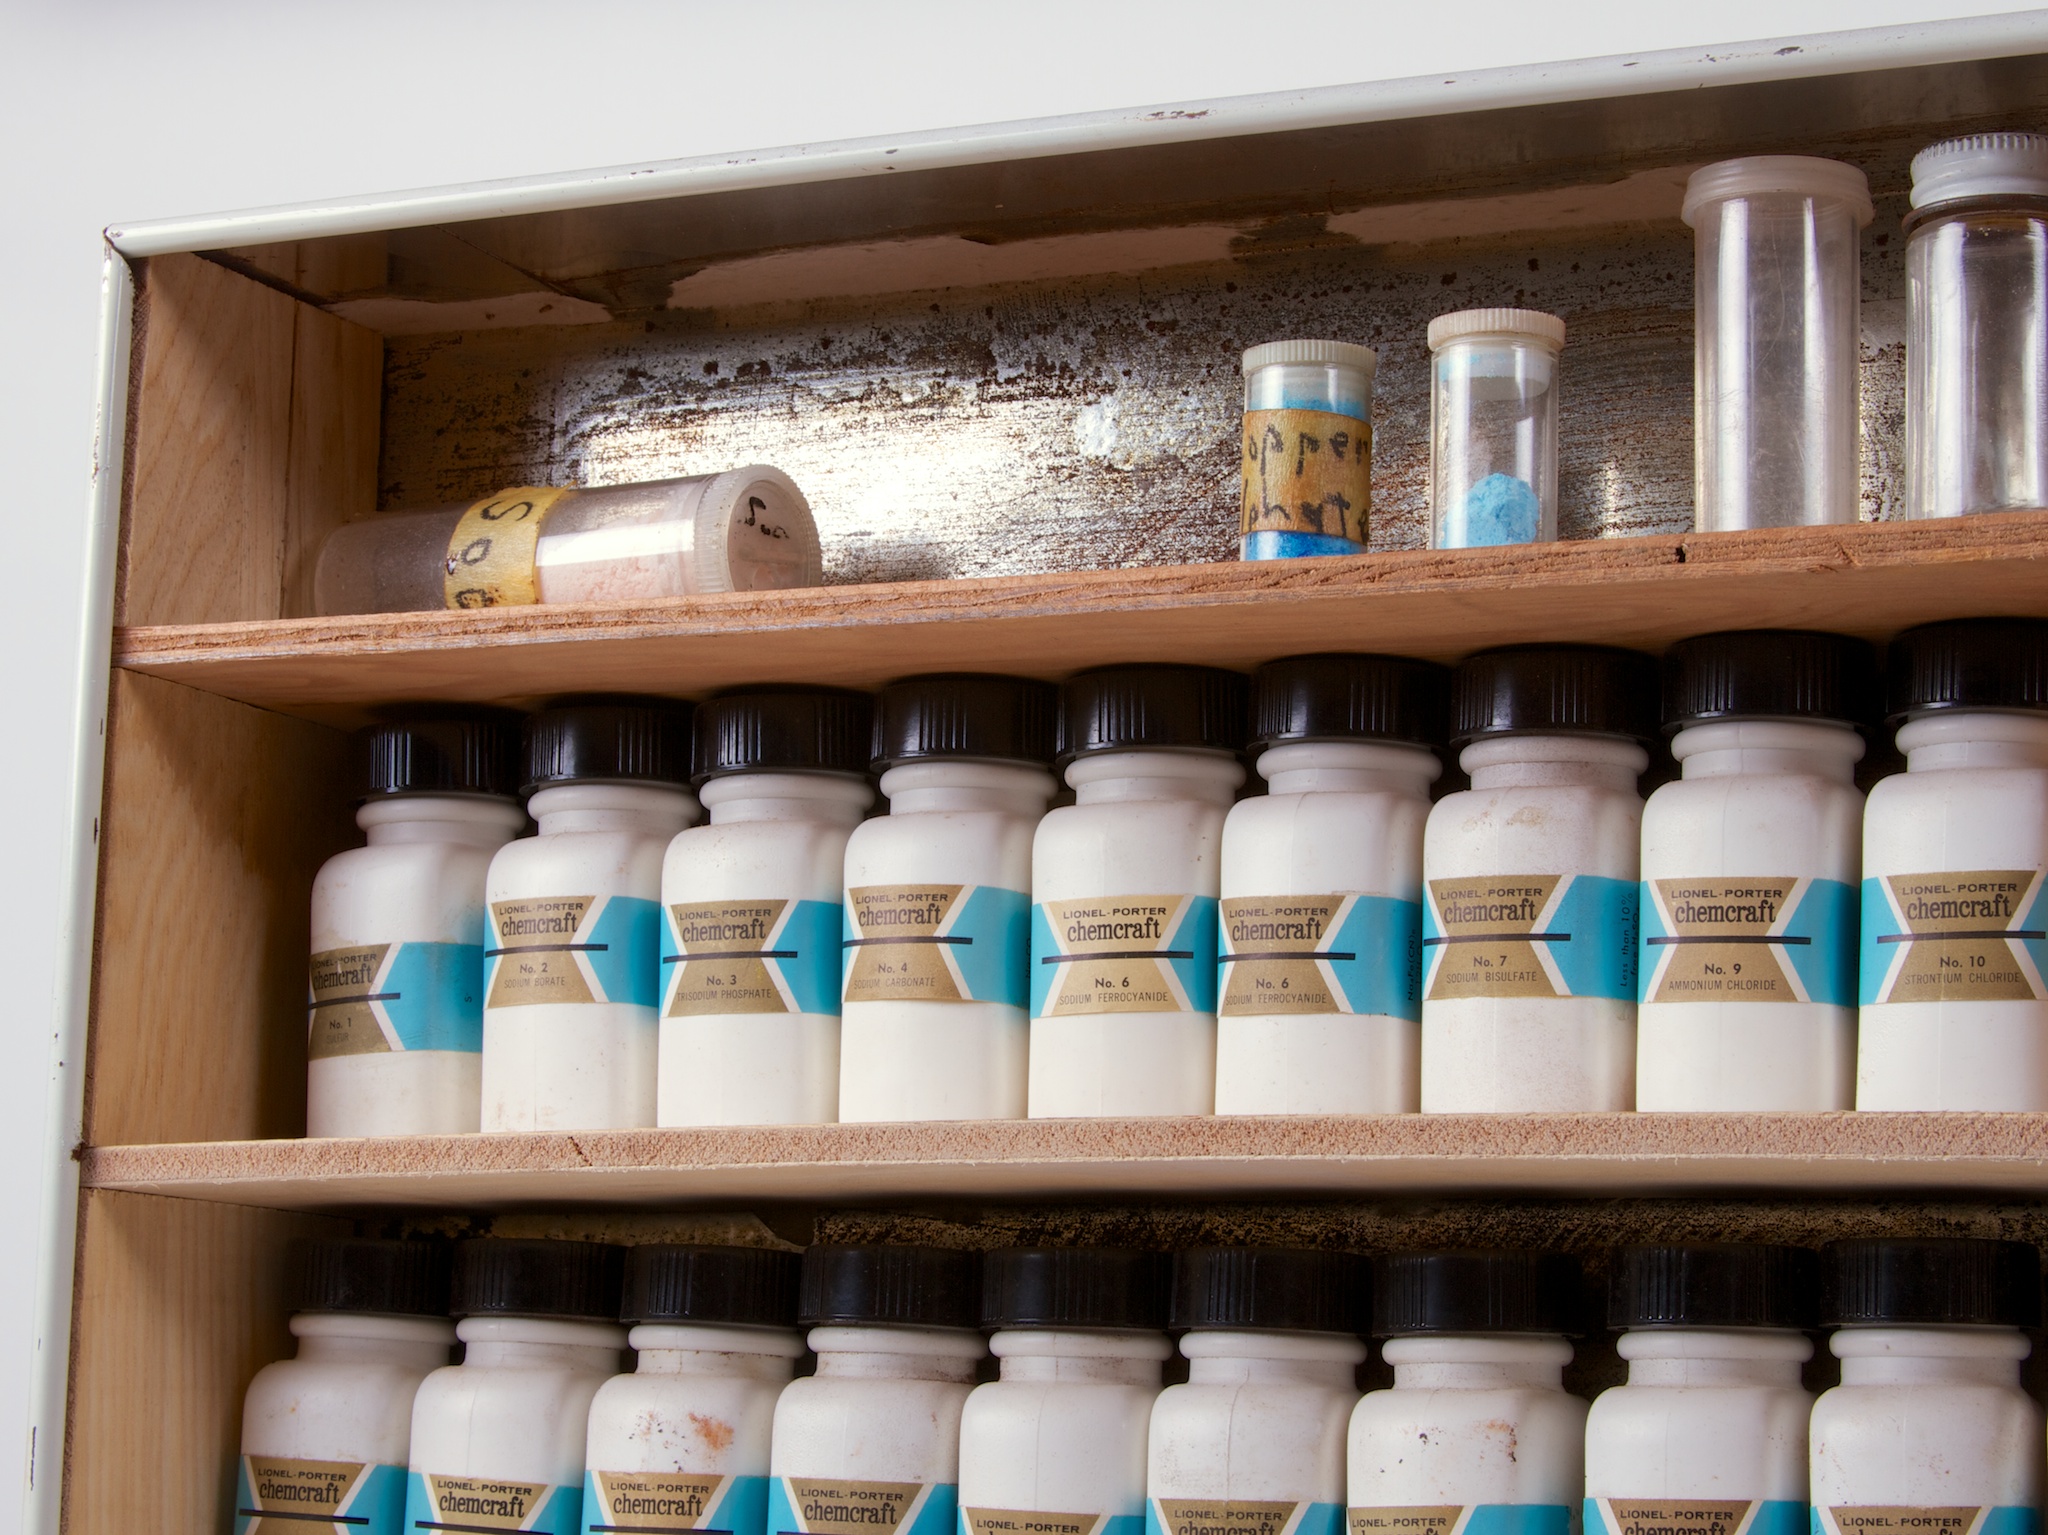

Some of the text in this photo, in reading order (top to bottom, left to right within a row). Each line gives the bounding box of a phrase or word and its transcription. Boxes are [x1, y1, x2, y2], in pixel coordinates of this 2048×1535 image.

[1443, 898, 1538, 924] chemcraft
[1621, 893, 1633, 921] 10%
[1675, 899, 1777, 924] chemcraft
[1907, 894, 2013, 920] chemcraft
[858, 903, 942, 927] chemcraft
[501, 912, 578, 937] chemcraft
[682, 918, 767, 943] chemcraft
[1067, 917, 1162, 943] chemcraft
[1232, 917, 1323, 942] chemcraft
[1621, 929, 1630, 955] than
[520, 962, 548, 974] No. 2
[878, 962, 908, 974] No. 4
[1473, 955, 1507, 968] No. 7
[1939, 955, 1986, 968] No. 10
[1704, 963, 1742, 975] No. 9
[313, 963, 373, 991] chemcraft
[504, 976, 565, 989] SODIUM BORATE
[706, 974, 737, 986] No. 3
[854, 976, 935, 990] SODIUM CARBONATE
[1095, 976, 1130, 989] No. 6
[1255, 977, 1289, 990] No. 6
[1446, 971, 1537, 984] SODIUM BISULFATE
[1904, 972, 2021, 985] STRONTIUM CHLORIDE
[1668, 979, 1777, 991] AMMONIUM CHLORIDE
[677, 988, 772, 1002] TRISODIUM PHOSPHATE
[1059, 991, 1169, 1006] SODIUM FERROCYANIDE
[1225, 993, 1327, 1006] SODIUM FERROCYANIDE
[329, 1017, 352, 1030] No. 1
[259, 1479, 340, 1504] chemcraft
[439, 1491, 525, 1519] chemcraft
[613, 1493, 703, 1517] chemcraft
[804, 1499, 898, 1525] chemcraft
